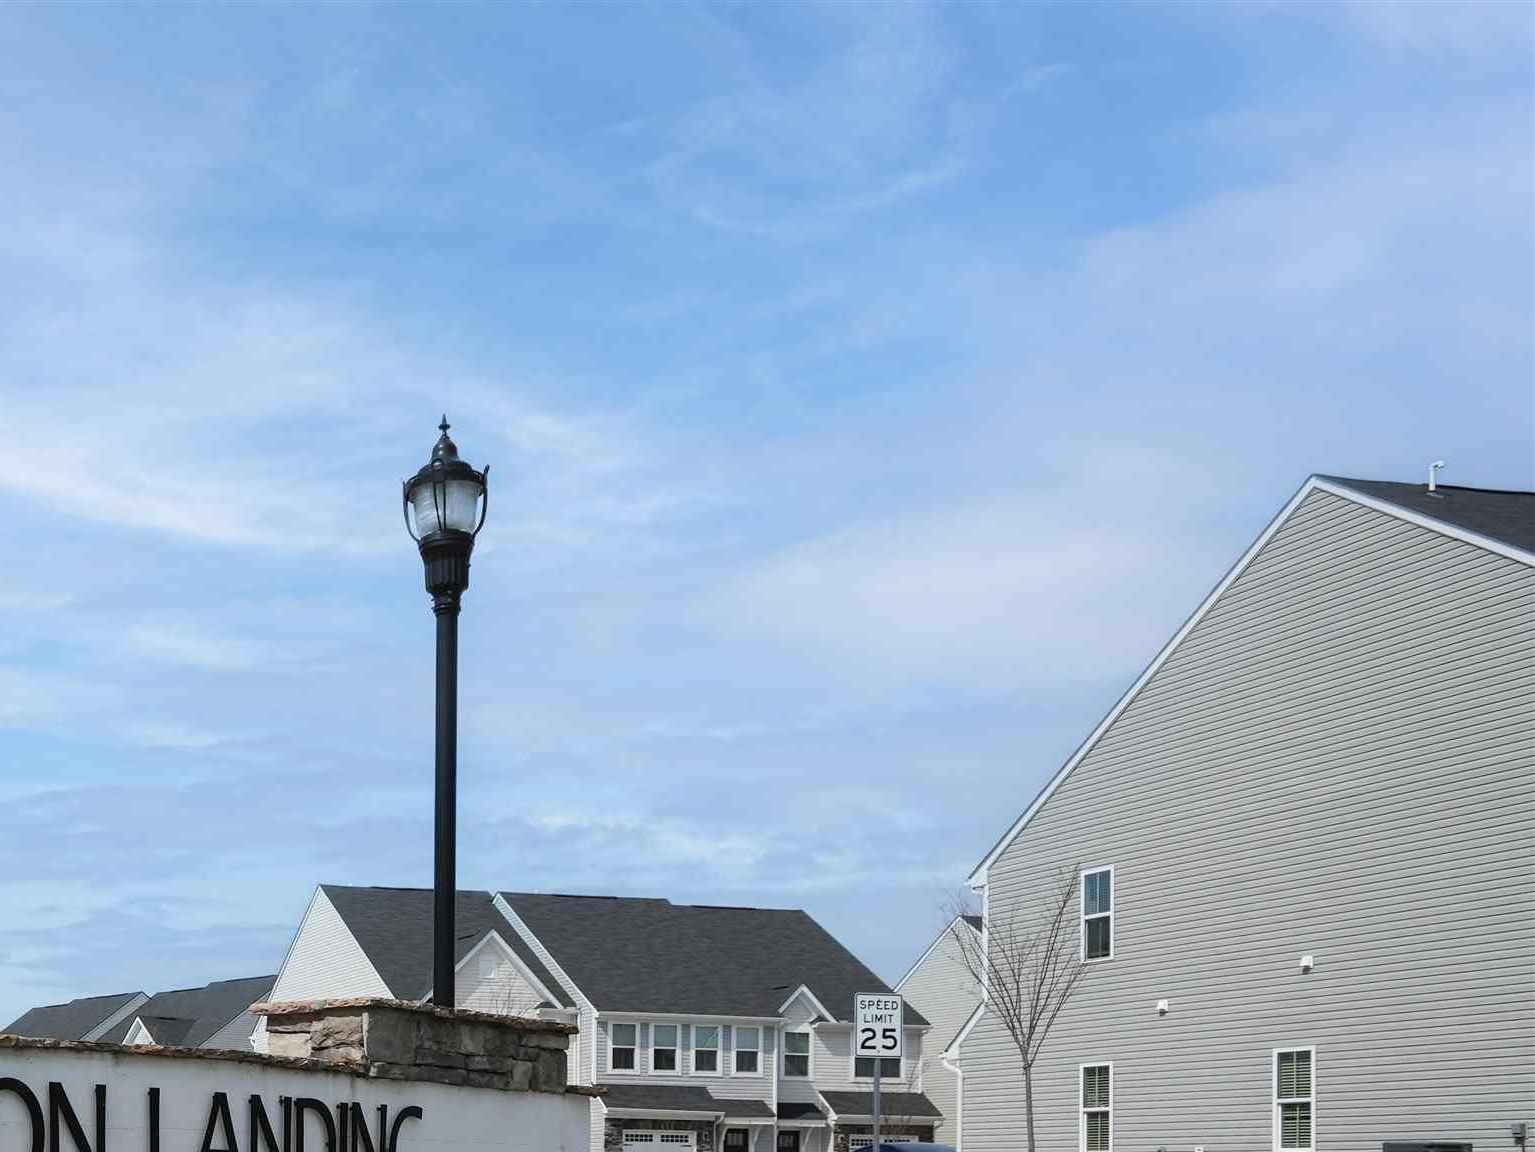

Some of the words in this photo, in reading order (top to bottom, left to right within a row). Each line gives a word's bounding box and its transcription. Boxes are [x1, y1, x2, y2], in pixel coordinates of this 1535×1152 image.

[860, 1000, 898, 1010] SPEED
[864, 1014, 894, 1024] LIMIT
[860, 1028, 898, 1050] 25
